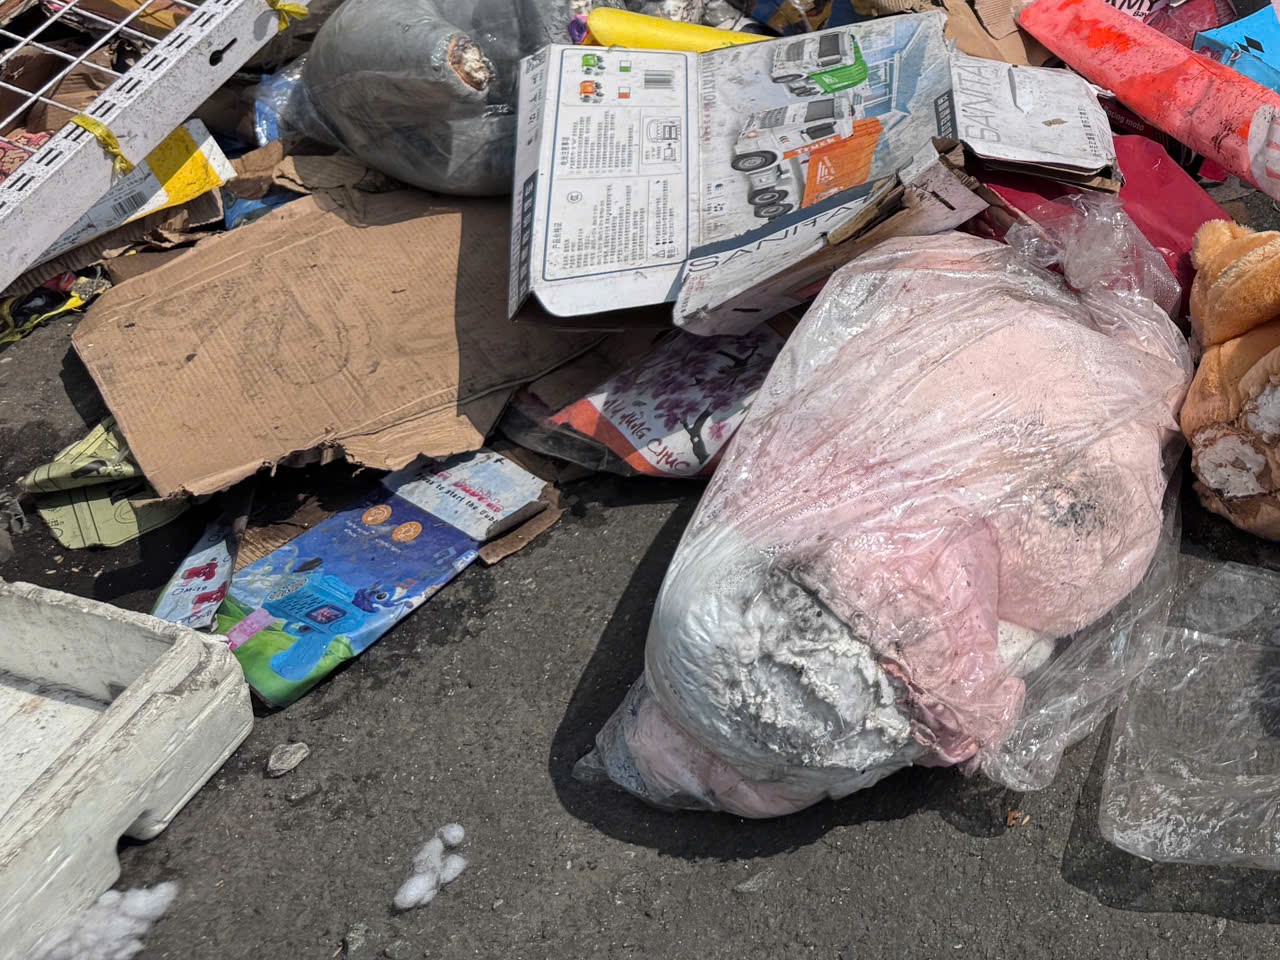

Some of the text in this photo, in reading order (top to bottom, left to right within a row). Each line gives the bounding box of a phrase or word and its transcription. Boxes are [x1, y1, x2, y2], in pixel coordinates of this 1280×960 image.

[1125, 116, 1145, 132] moto
[435, 483, 445, 491] to
[446, 488, 465, 503] start
[465, 499, 479, 511] the
